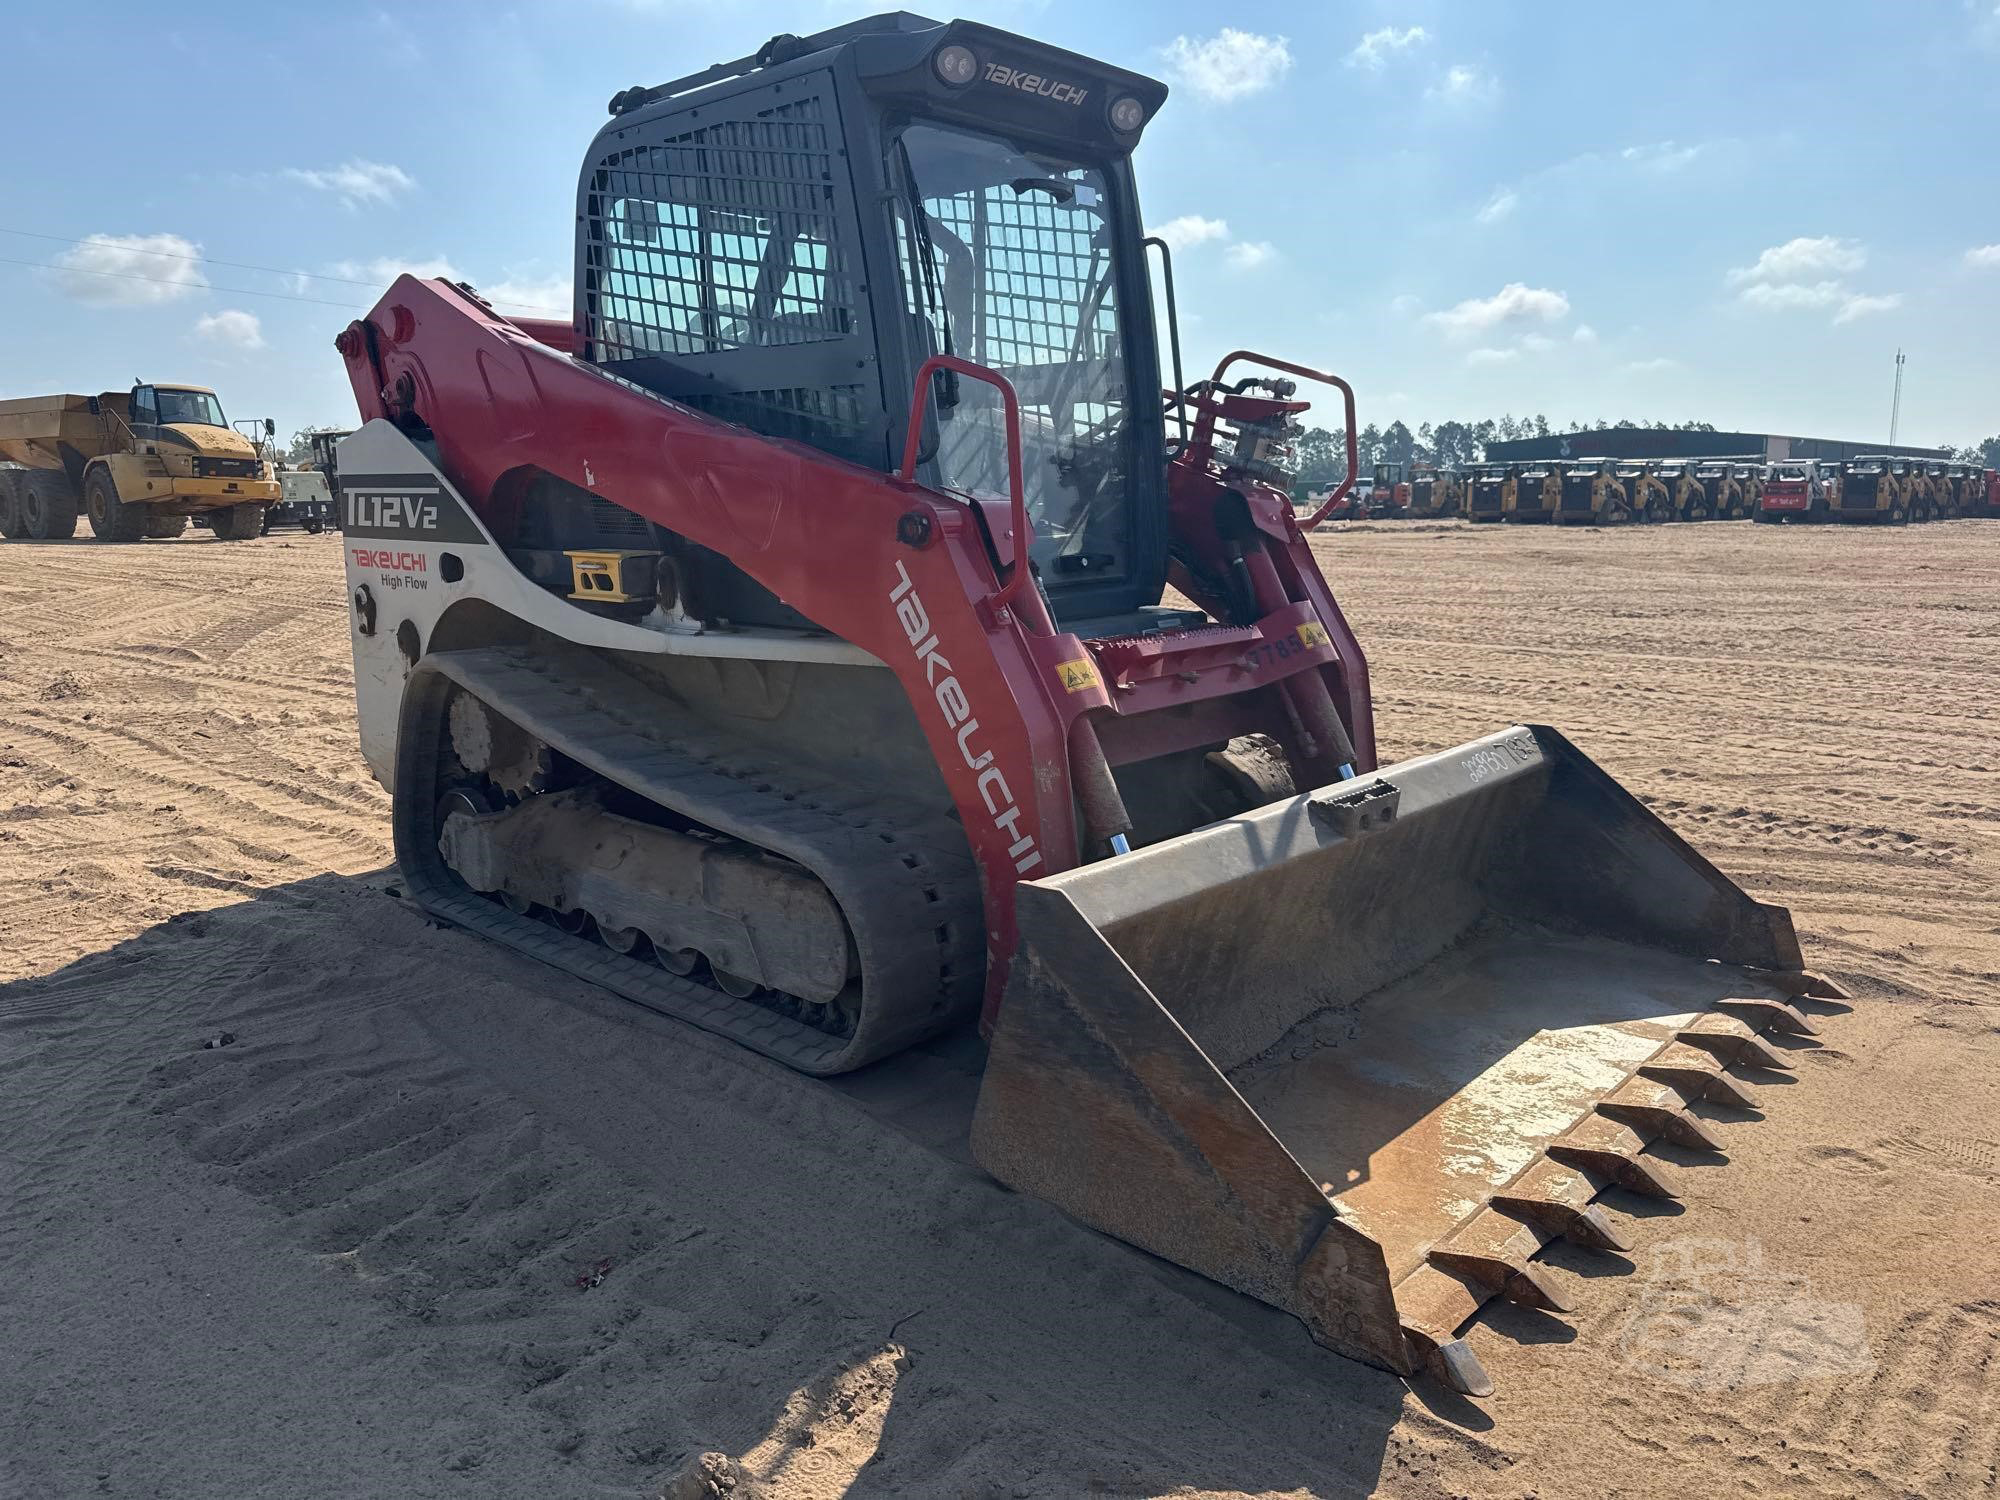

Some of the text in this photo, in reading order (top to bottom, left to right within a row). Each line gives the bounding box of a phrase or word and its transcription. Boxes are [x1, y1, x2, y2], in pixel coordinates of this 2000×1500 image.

[983, 62, 1089, 106] TAKEUCHI
[343, 487, 440, 529] TL12V2
[351, 549, 427, 572] TAKEUCHI
[381, 573, 428, 590] High Flow
[889, 559, 1042, 874] TAKEUCHI
